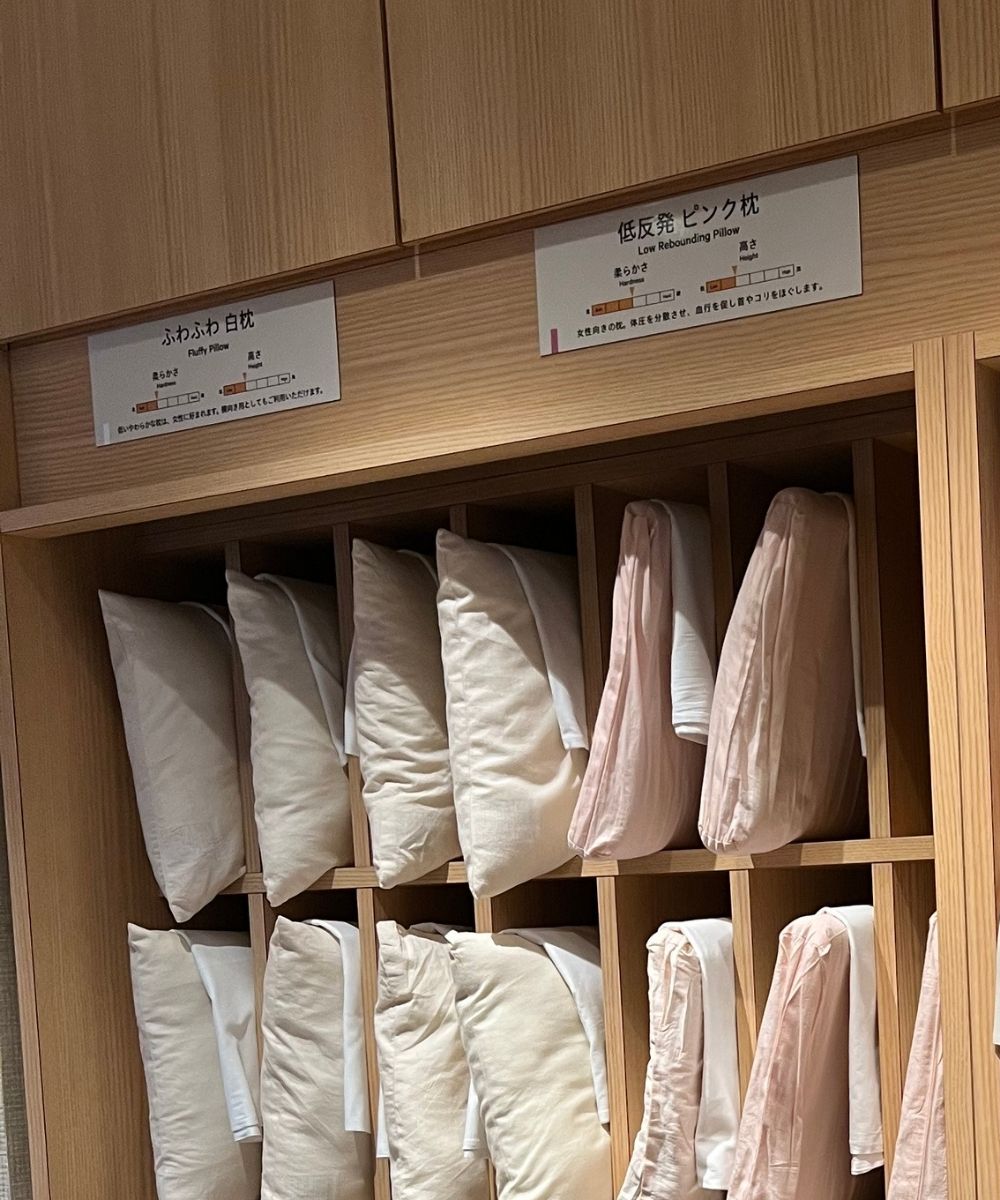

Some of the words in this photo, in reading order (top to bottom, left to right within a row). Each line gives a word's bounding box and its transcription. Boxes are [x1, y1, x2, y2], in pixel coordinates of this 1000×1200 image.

[618, 211, 674, 244] 低反発
[683, 192, 760, 228] ピンク枕
[638, 243, 655, 255] Low
[658, 231, 711, 251] Rebounding
[713, 226, 740, 239] Pillow
[739, 239, 757, 252] 高さ
[614, 262, 648, 278] 柔らかさ
[161, 318, 219, 346] ふわふわ
[225, 308, 255, 333] 白枕
[209, 342, 230, 354] Pillow
